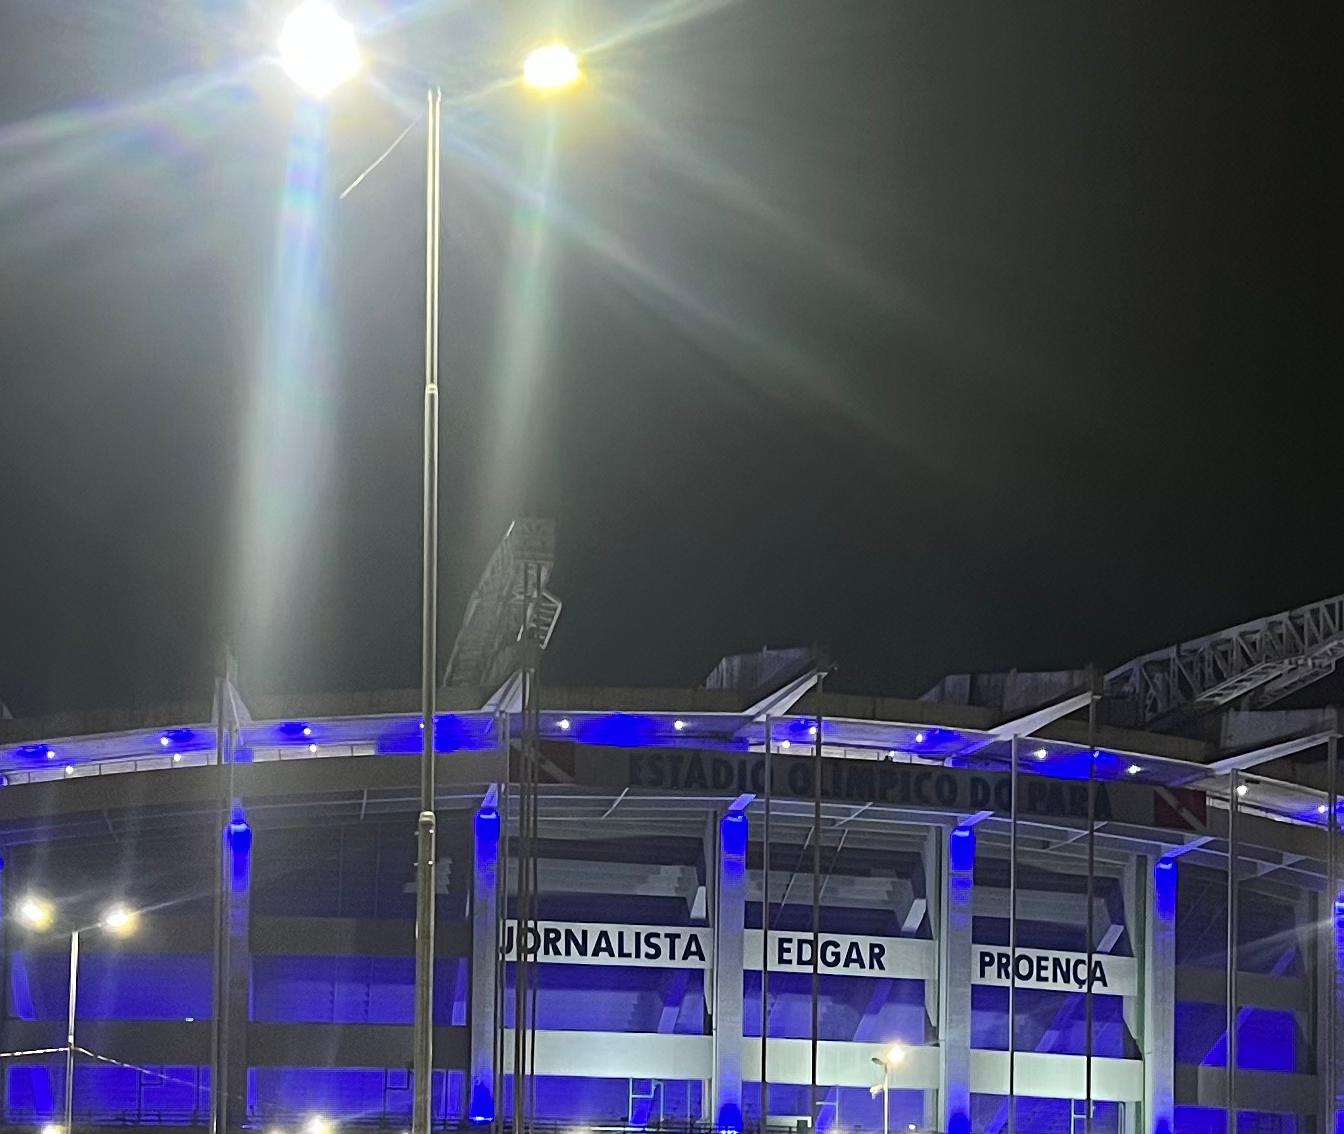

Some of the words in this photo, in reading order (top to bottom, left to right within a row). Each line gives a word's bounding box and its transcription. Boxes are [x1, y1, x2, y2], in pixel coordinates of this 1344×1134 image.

[499, 926, 706, 962] JORNALISTA
[777, 937, 886, 970] EDGAR
[979, 950, 1109, 990] PROENÇA
